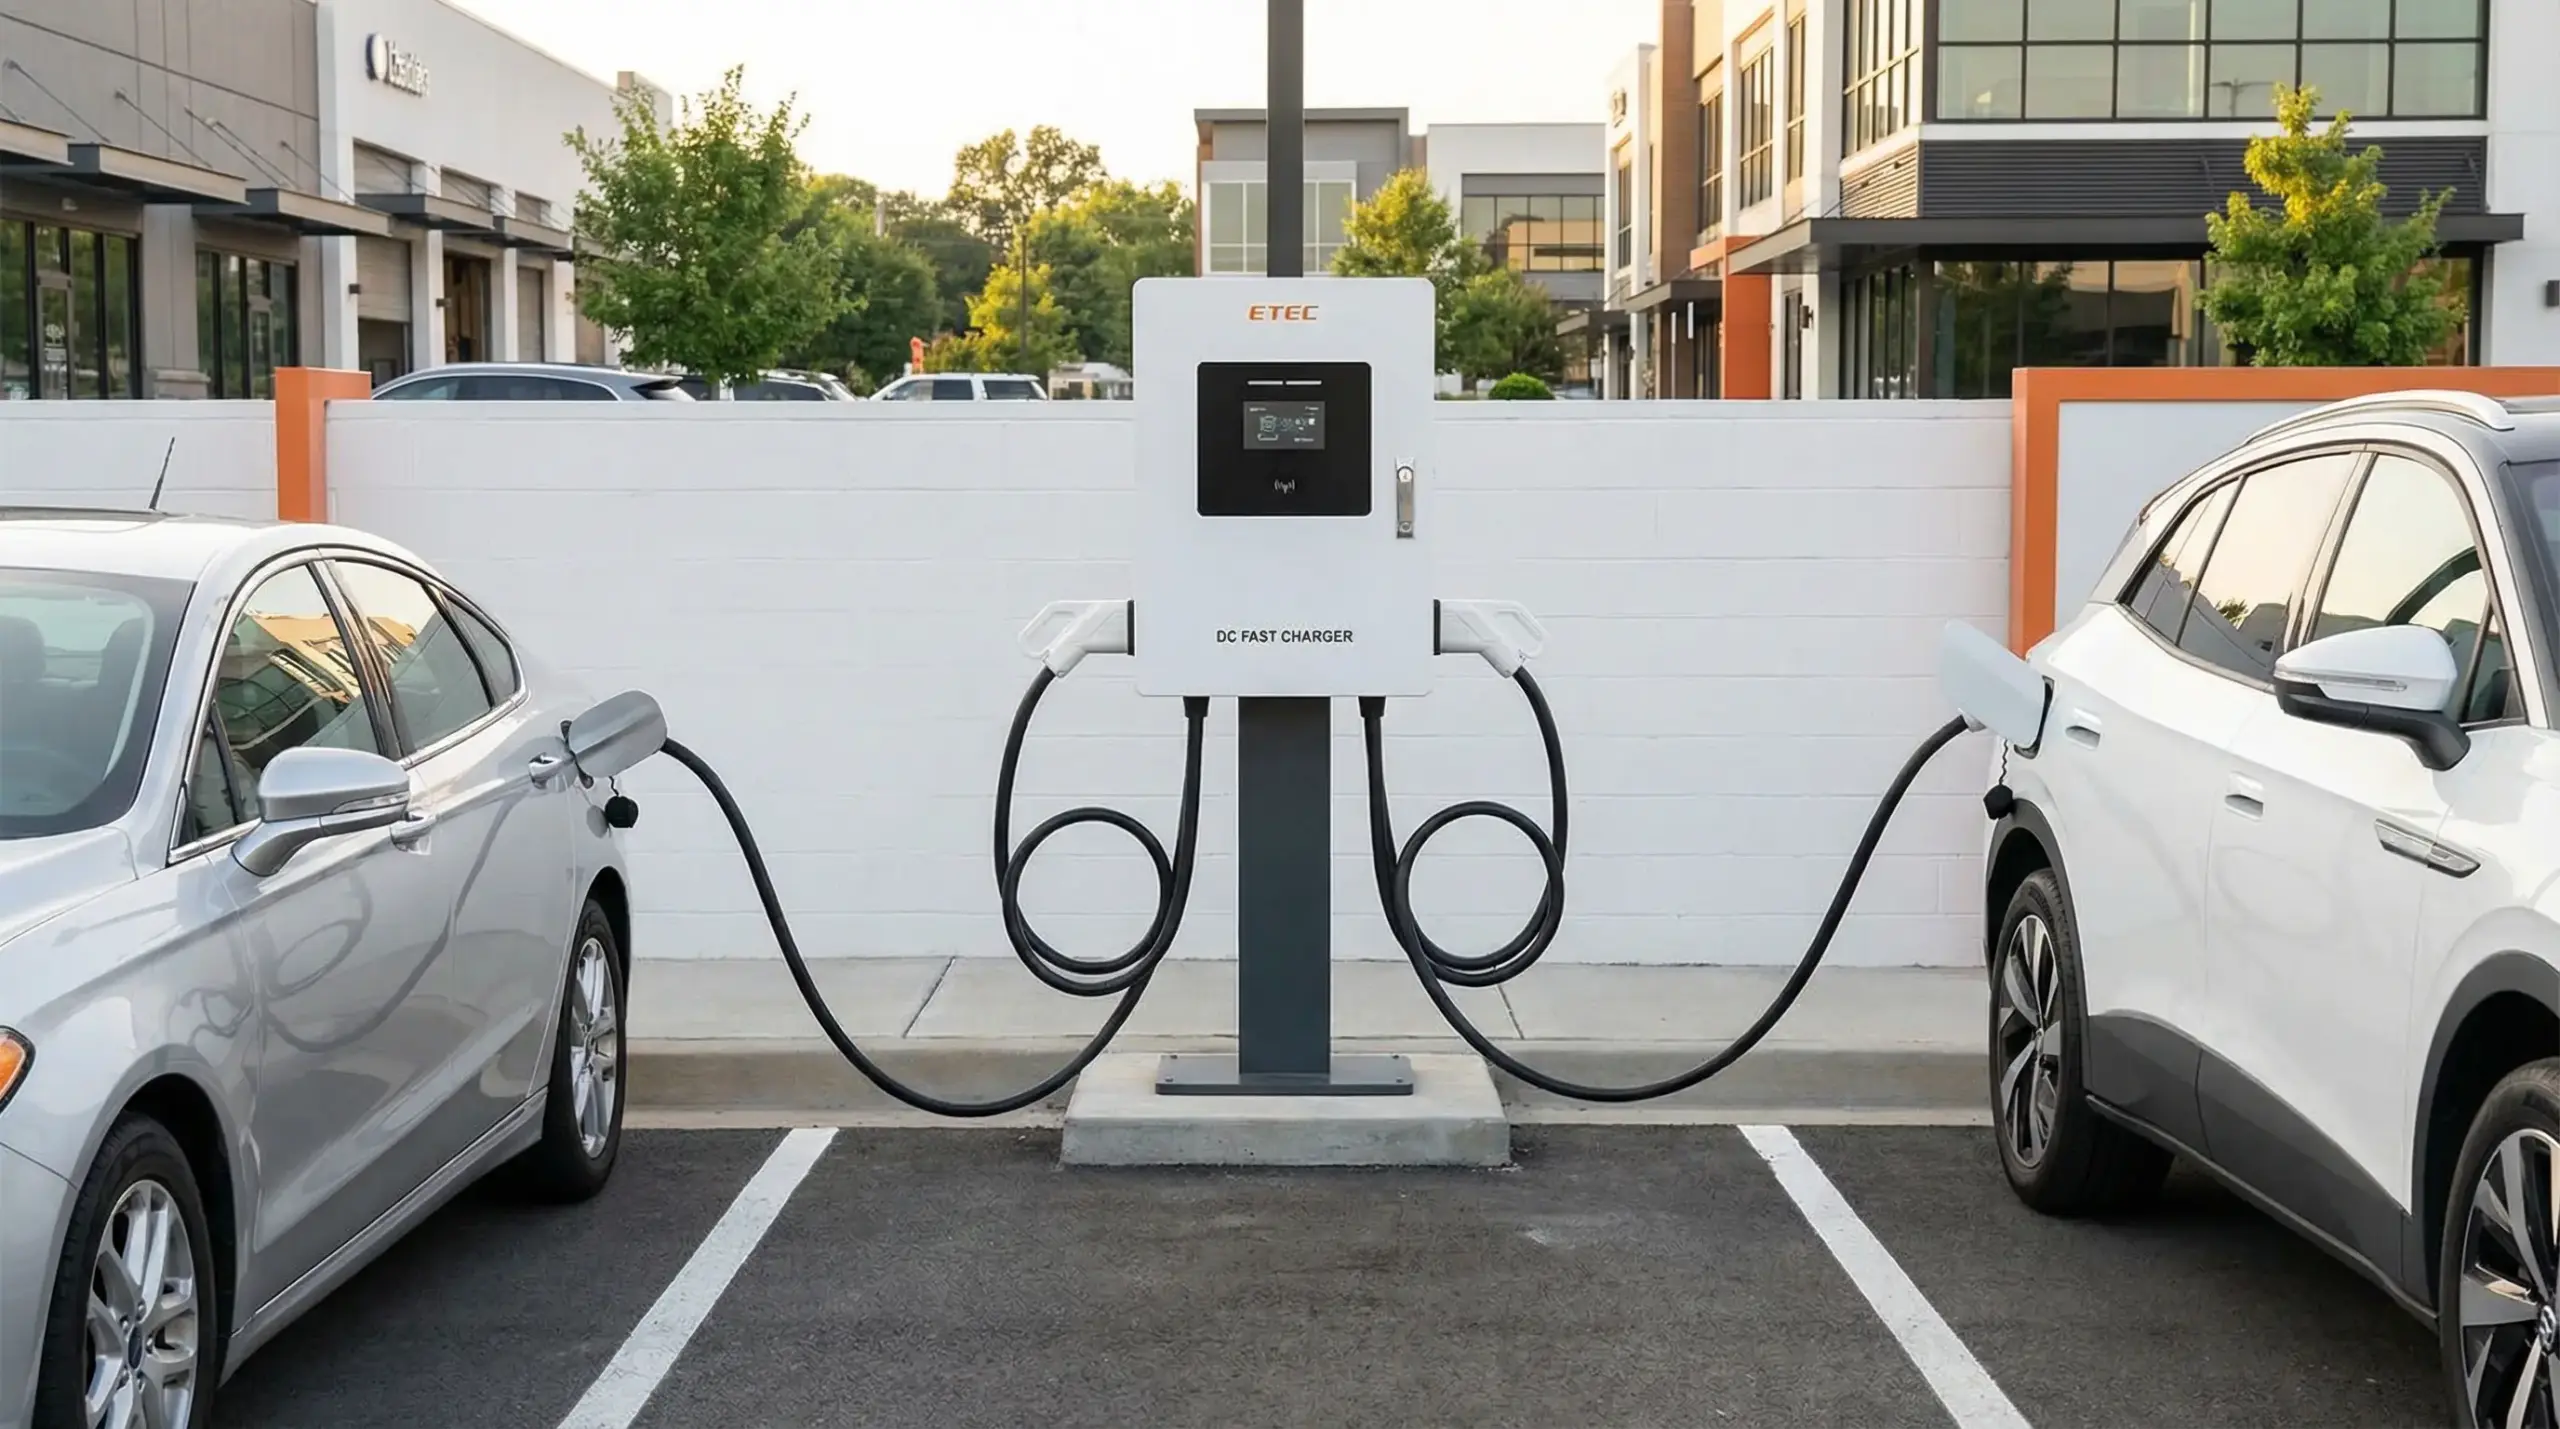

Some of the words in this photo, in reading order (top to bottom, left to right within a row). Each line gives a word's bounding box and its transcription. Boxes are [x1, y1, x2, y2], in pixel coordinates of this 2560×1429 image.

[1248, 305, 1319, 321] ETEC
[1216, 630, 1237, 643] DC
[1241, 630, 1277, 643] FAST
[1281, 630, 1354, 643] CHARGER
